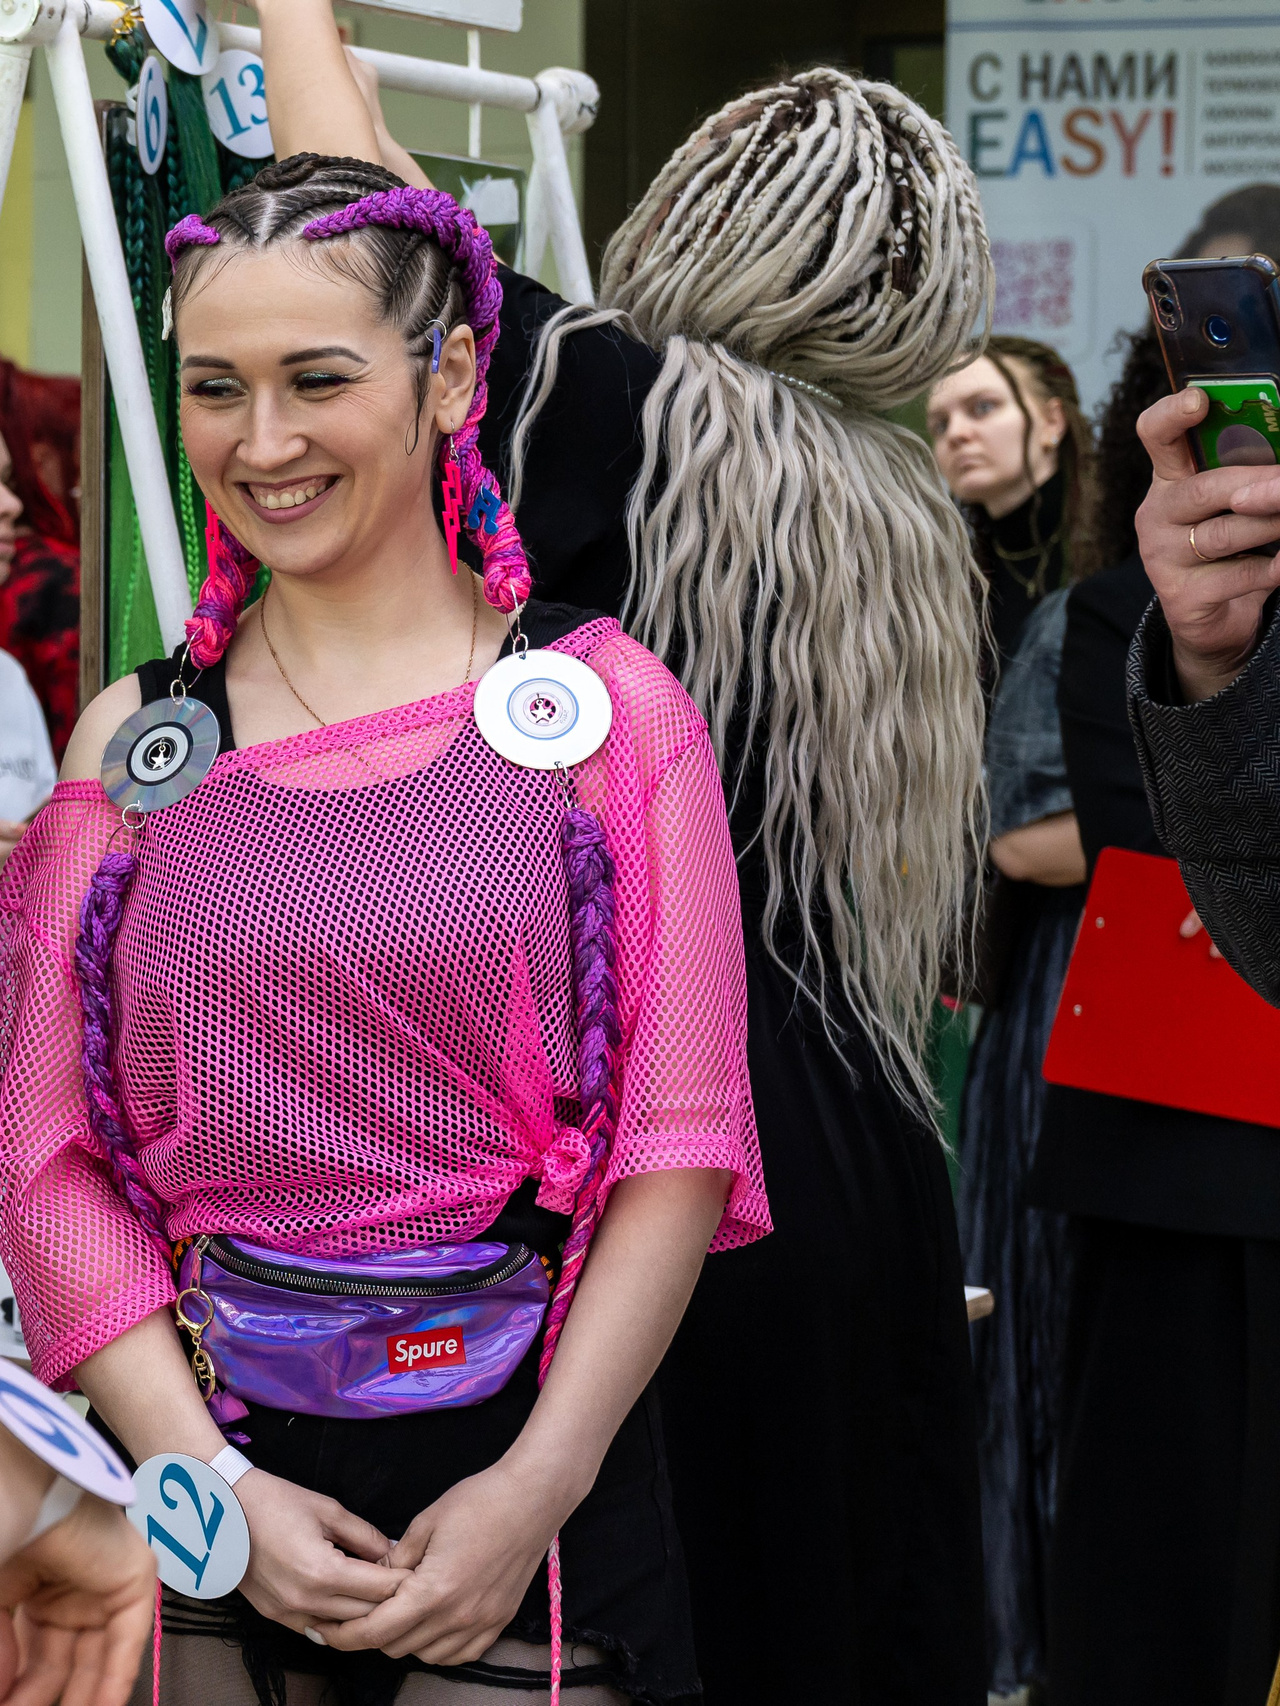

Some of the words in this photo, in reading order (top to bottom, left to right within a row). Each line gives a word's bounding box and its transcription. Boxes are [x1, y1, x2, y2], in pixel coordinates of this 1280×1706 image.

[209, 63, 269, 141] 13
[968, 51, 1003, 102] С
[1019, 50, 1177, 102] НАМИ
[967, 107, 1177, 179] EASY!
[394, 1338, 458, 1367] Spure
[146, 1462, 225, 1591] 12
